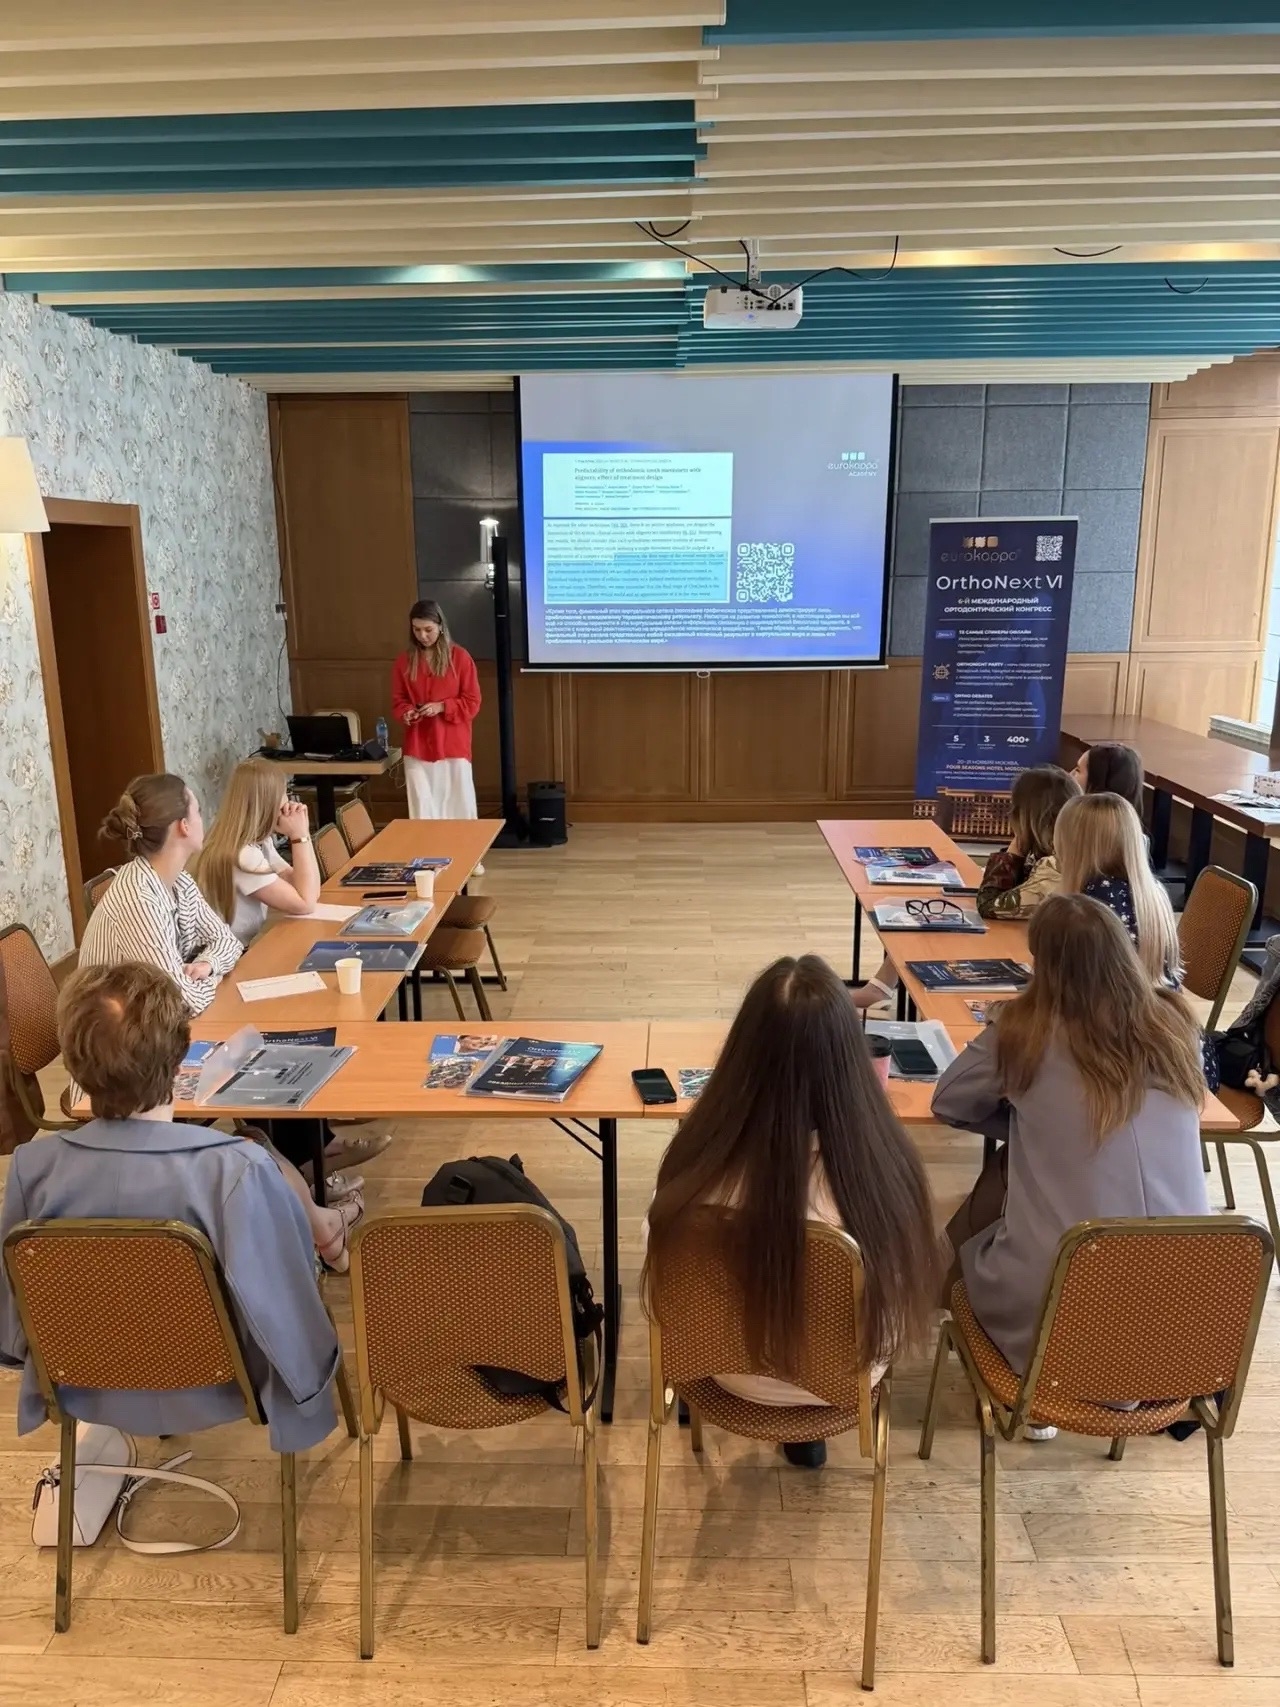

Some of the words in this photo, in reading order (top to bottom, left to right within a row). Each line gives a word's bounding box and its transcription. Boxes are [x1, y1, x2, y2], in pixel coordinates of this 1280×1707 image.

[936, 575, 1042, 590] OrthoNext
[1045, 575, 1063, 589] VI
[944, 605, 1014, 613] ОРТОДОНТИЧЕСКИЙ
